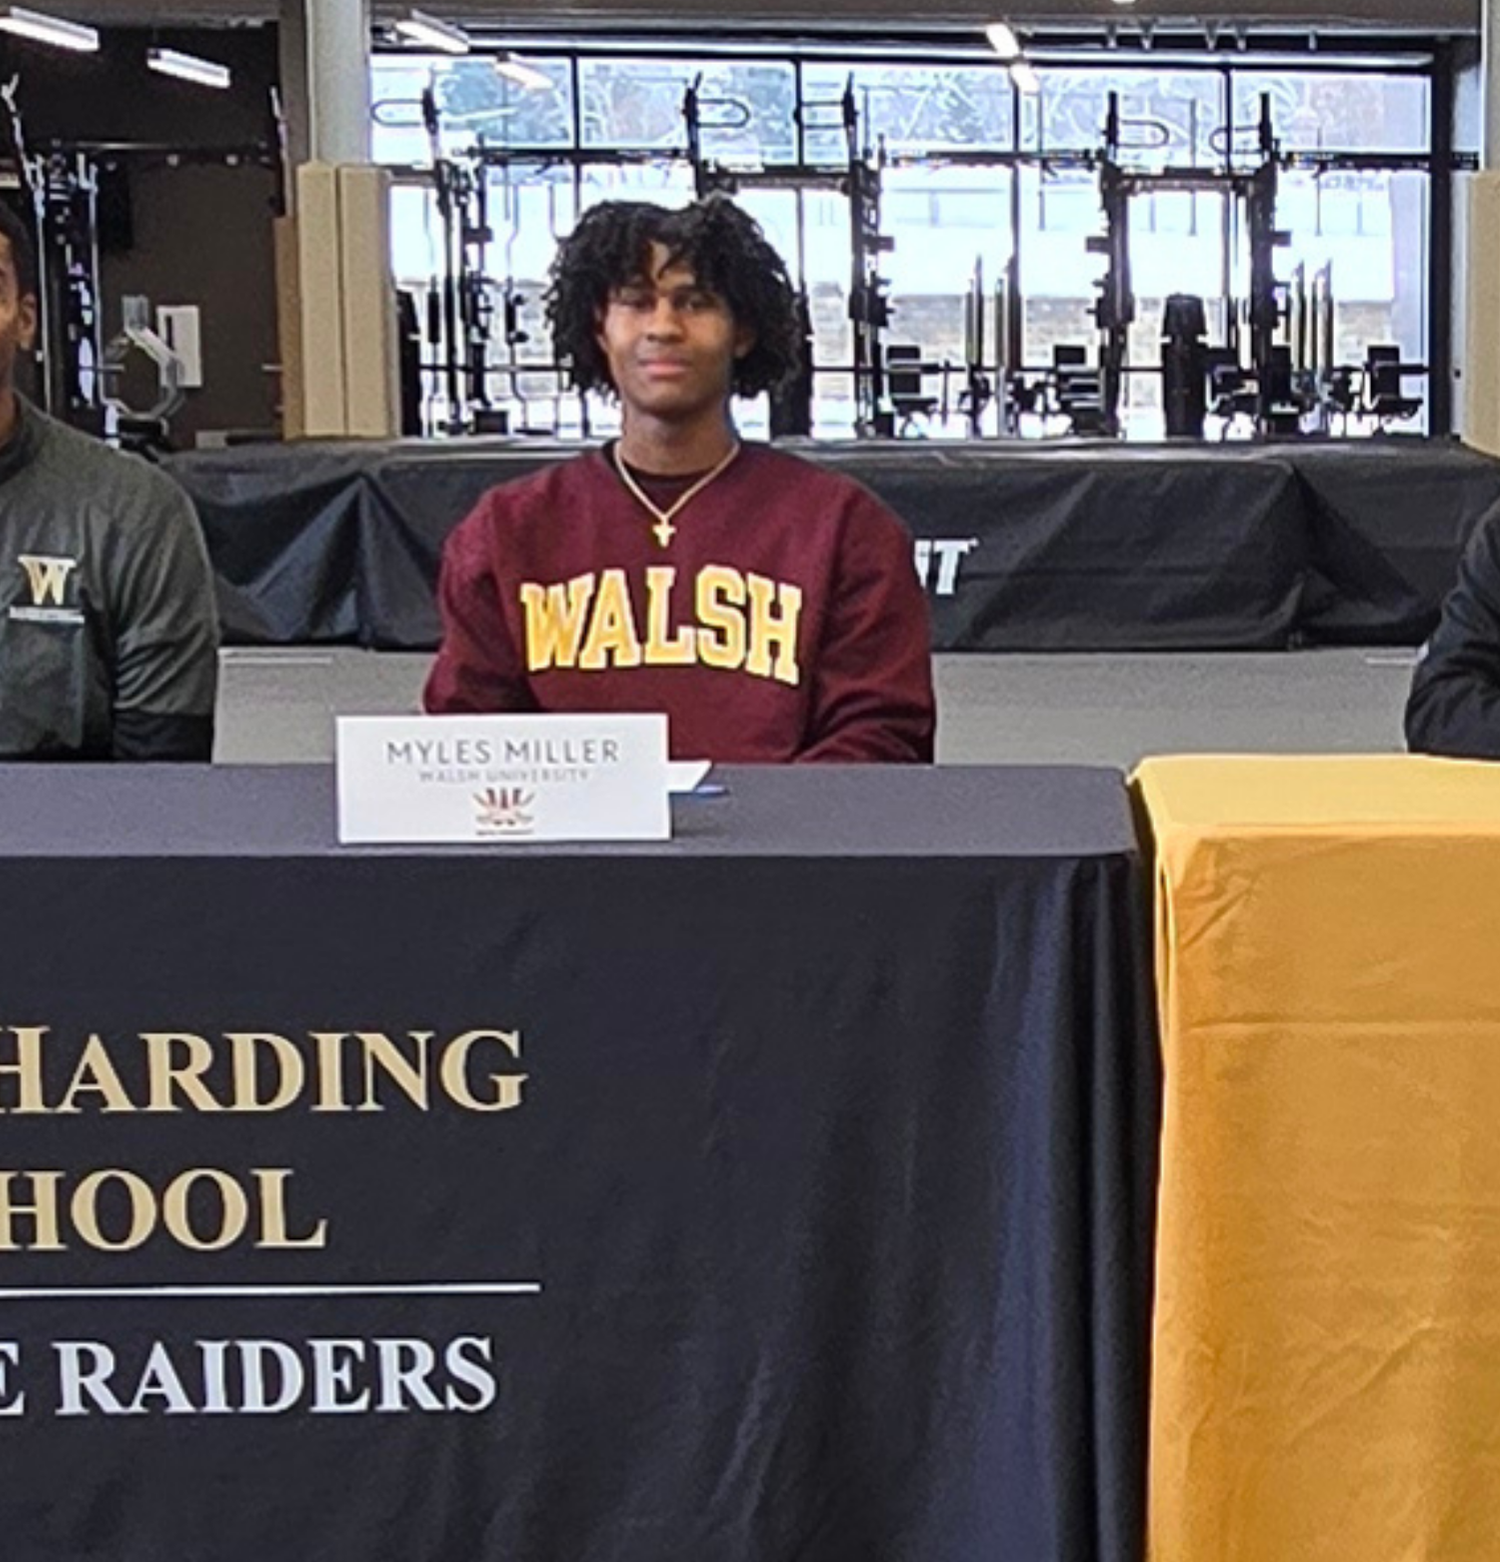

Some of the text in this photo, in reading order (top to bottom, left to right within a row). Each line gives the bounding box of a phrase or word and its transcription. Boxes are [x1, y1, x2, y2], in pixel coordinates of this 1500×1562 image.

[17, 553, 77, 606] W
[520, 563, 802, 685] WALSH
[386, 738, 619, 766] MYLES MILLER
[418, 767, 588, 784] WALSH UNIVERSITY
[51, 1336, 496, 1416] RAIDERS
